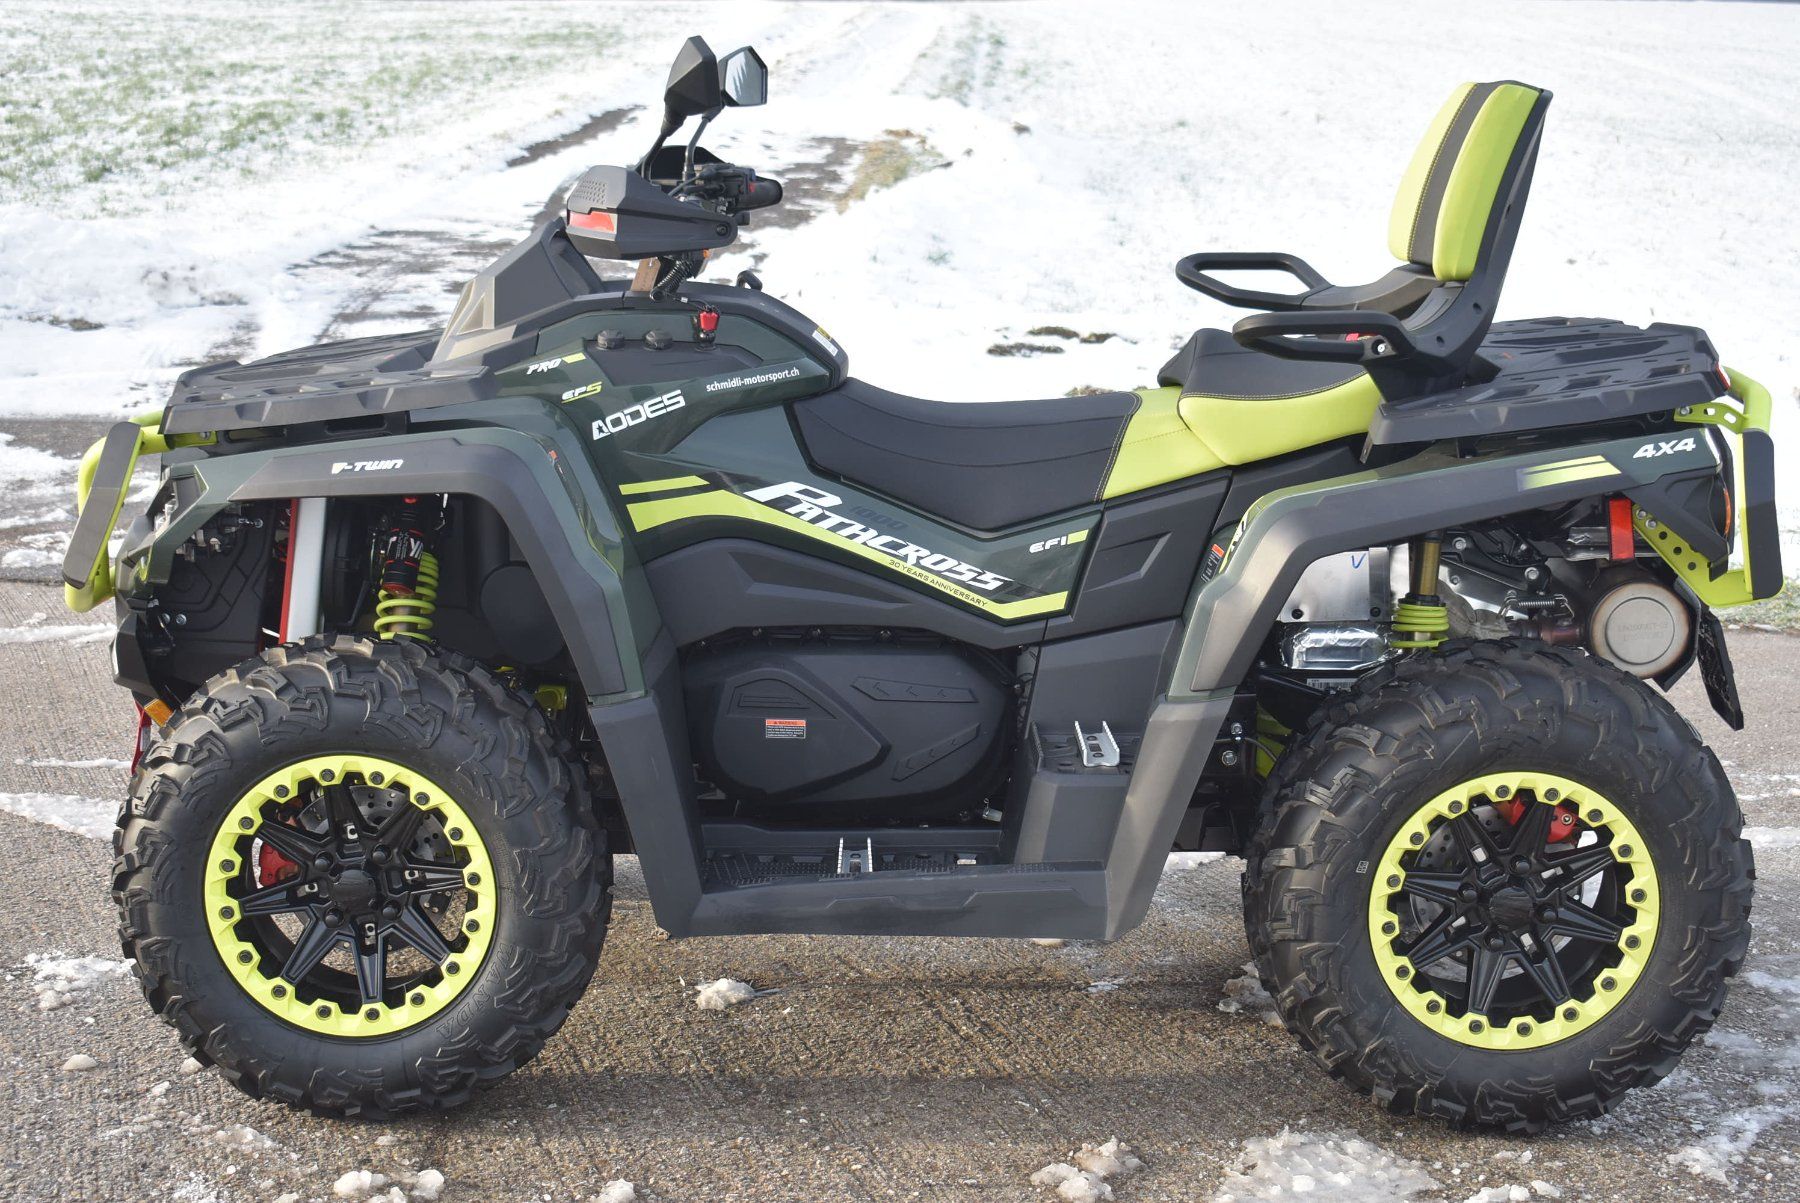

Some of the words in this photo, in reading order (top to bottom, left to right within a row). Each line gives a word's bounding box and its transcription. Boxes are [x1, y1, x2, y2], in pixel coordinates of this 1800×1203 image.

[526, 358, 562, 375] PRO
[706, 366, 800, 392] schmidli-motorsport.ch
[561, 381, 603, 401] EPS
[592, 389, 686, 440] AODES
[743, 481, 1017, 591] PATHCROSS
[1029, 535, 1068, 554] EFI
[889, 559, 901, 568] 30
[901, 564, 930, 582] YEARS
[930, 578, 988, 607] ANNIVERSARY
